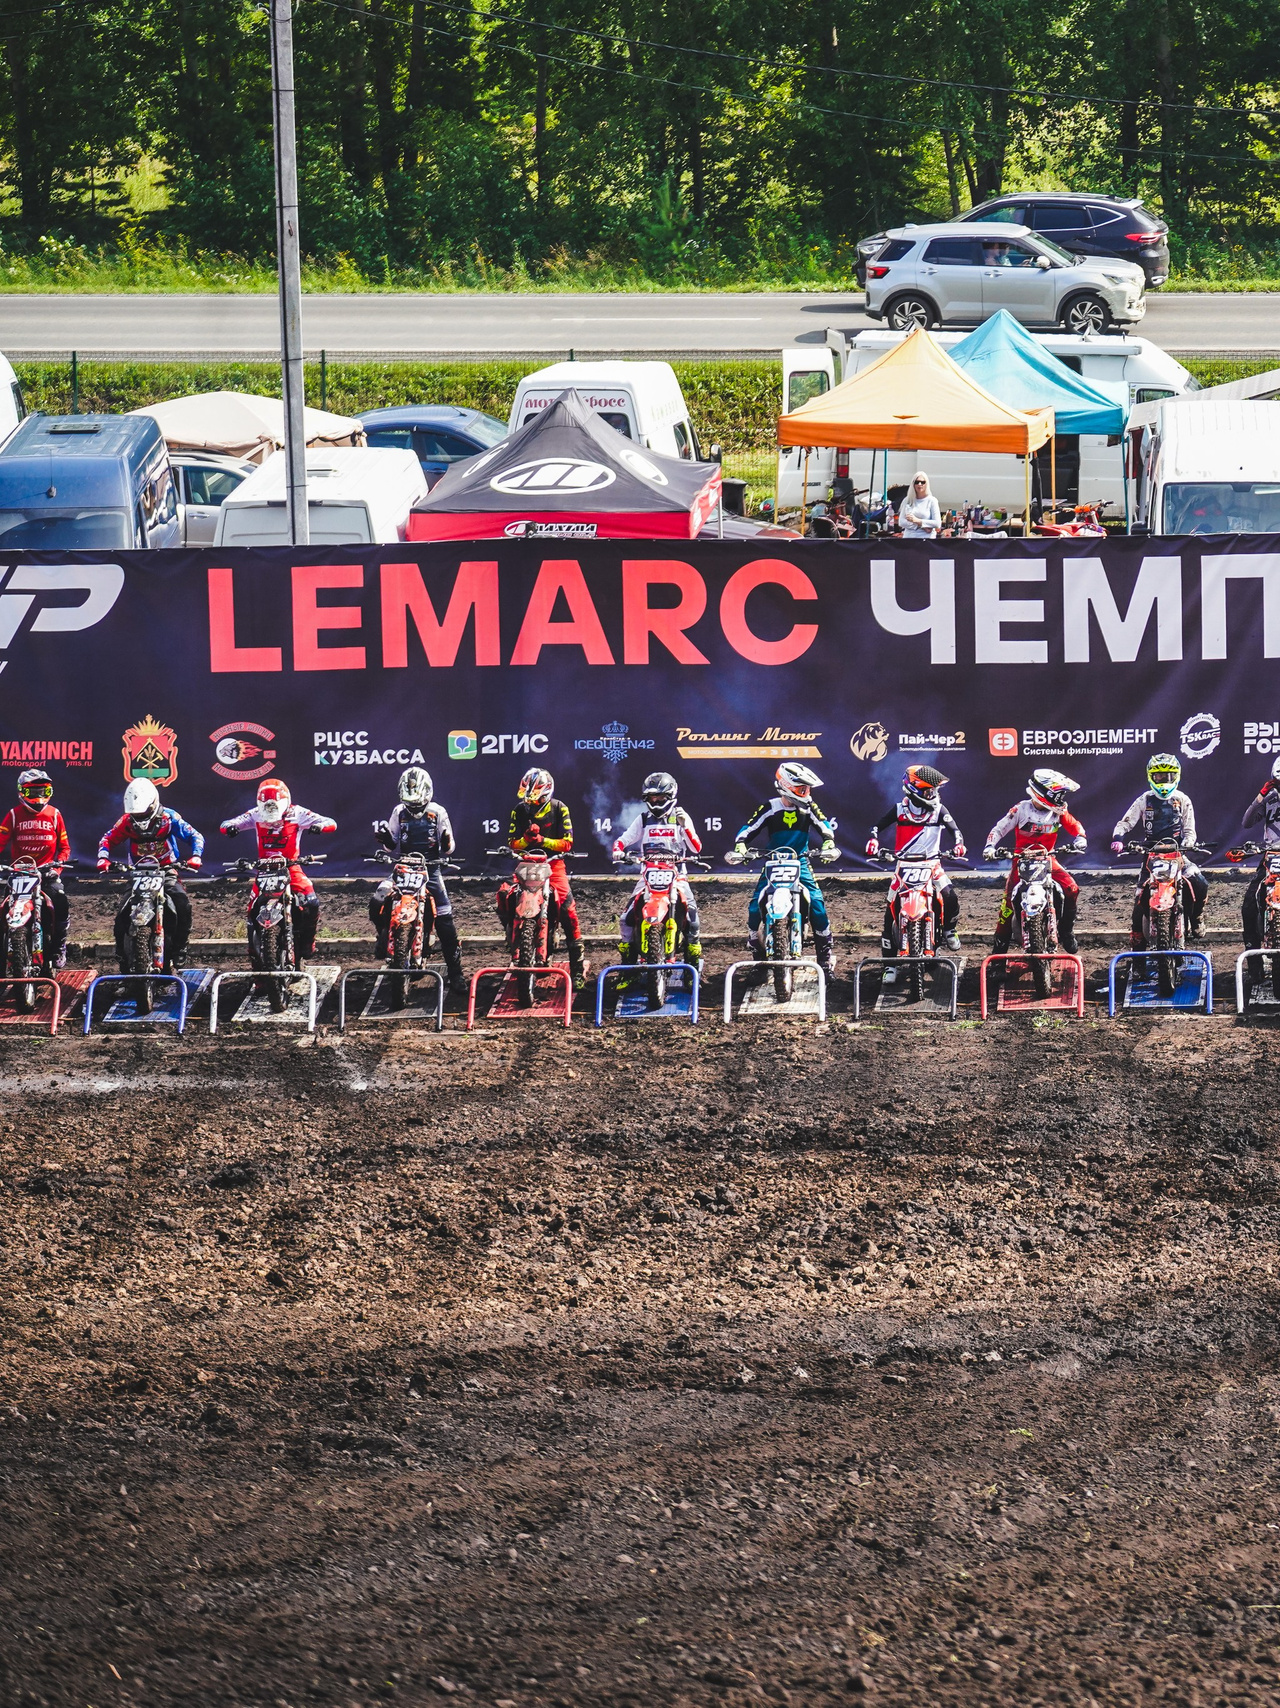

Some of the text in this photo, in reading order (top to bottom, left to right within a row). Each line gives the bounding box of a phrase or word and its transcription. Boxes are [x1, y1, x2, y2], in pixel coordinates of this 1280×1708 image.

[208, 558, 818, 673] LEMARC
[314, 731, 369, 747] РЦСС
[676, 727, 822, 741] Роллинг Мото
[899, 731, 966, 746] Пай-Чер2
[1023, 728, 1158, 745] ЕВРОЭЛЕМЕНТ
[0, 741, 93, 760] YAKHNICH
[481, 733, 549, 754] 2ГИС
[574, 739, 655, 750] ICEQUEEN42
[314, 749, 425, 765] КУЗБАССА
[1023, 747, 1123, 756] Системы фильтрации
[2, 760, 92, 768] motorsport yms.ru
[482, 819, 500, 833] 13
[594, 818, 612, 832] 14
[704, 817, 722, 831] 15
[648, 871, 674, 885] 888
[770, 866, 797, 882] 22
[902, 868, 931, 882] 730
[12, 876, 39, 894] 117
[132, 876, 162, 891] 738
